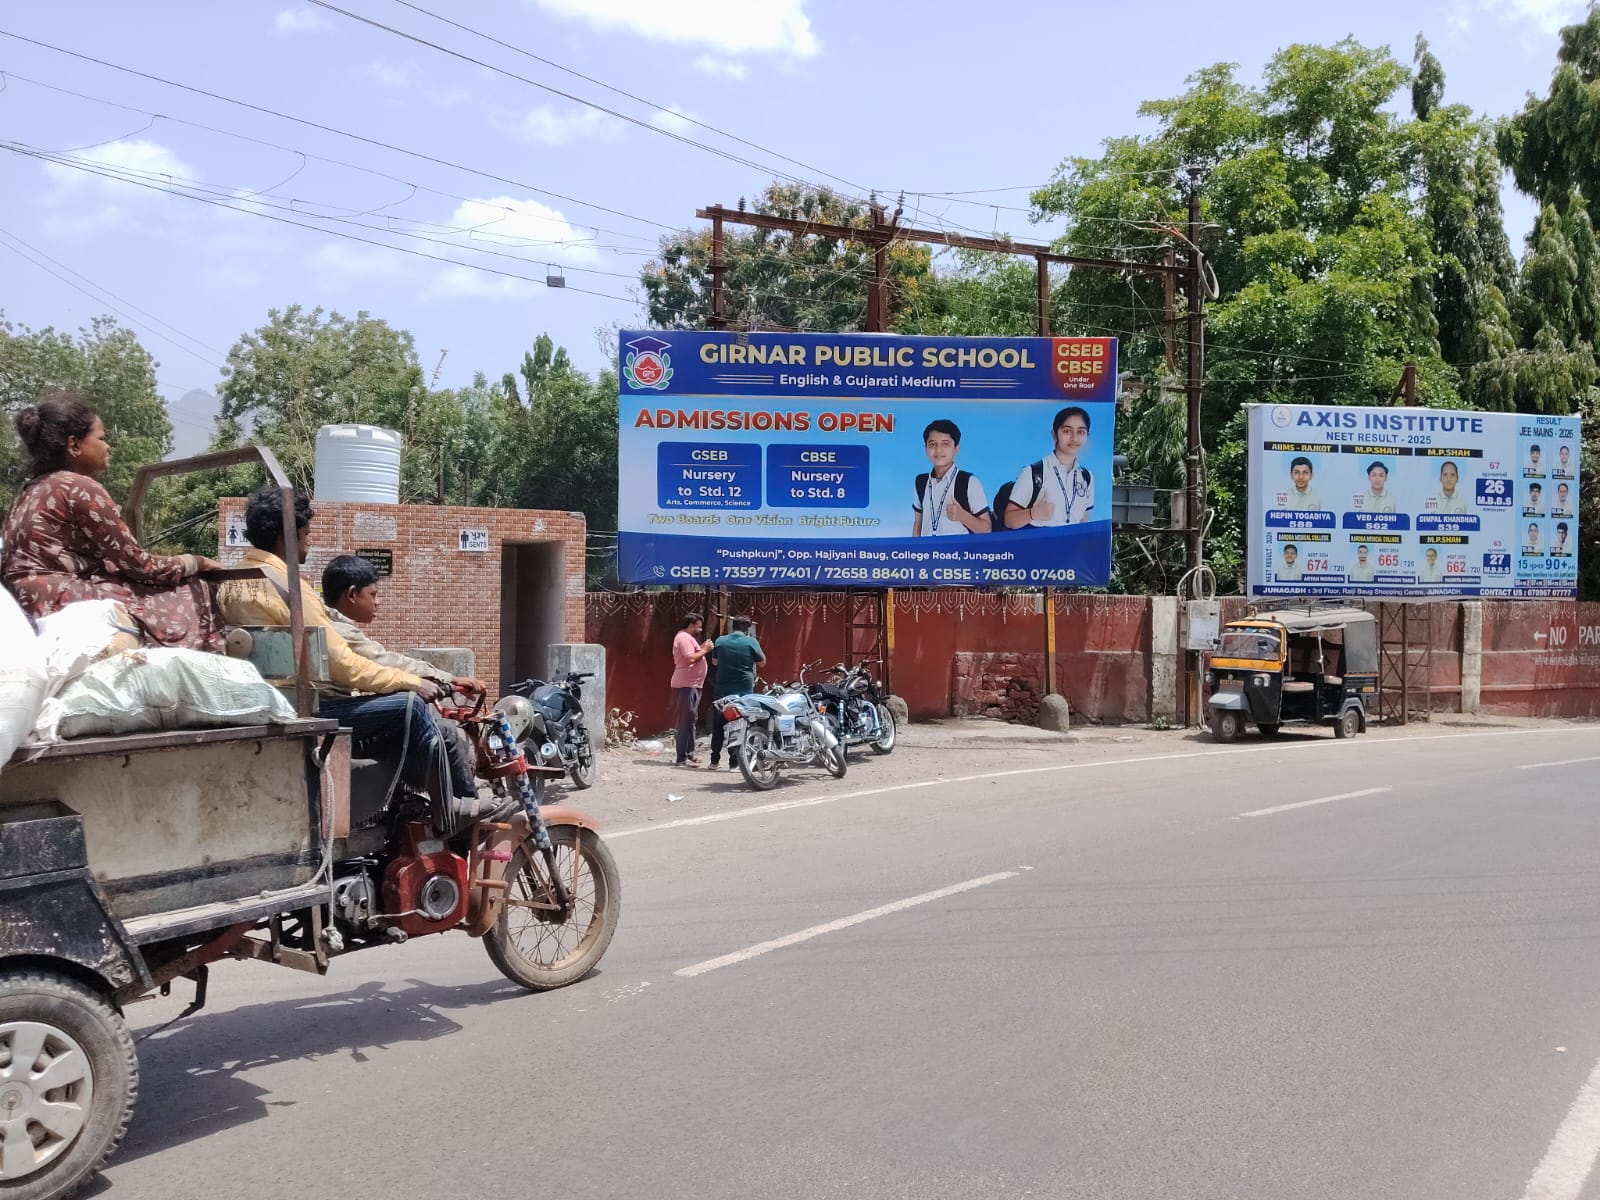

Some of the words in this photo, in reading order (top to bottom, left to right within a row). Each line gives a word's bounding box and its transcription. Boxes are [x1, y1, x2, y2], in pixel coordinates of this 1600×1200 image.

[700, 343, 805, 365] GIRNAR
[815, 345, 914, 367] PUBLIC
[922, 347, 1036, 369] SCHOOL
[1057, 343, 1104, 357] GSEB
[1056, 360, 1103, 374] CBSE
[779, 374, 829, 387] English
[833, 376, 842, 385] &
[845, 375, 898, 388] Gujarati
[901, 376, 956, 388] Medium
[635, 408, 810, 431] ADMISSIONS
[817, 411, 894, 433] OPEN
[1296, 410, 1357, 428] AXIS
[1365, 413, 1483, 433] INSTITUTE
[1536, 416, 1562, 425] RESULT
[1326, 431, 1354, 442] NEET
[1357, 433, 1398, 443] RESULT
[1407, 434, 1432, 445] 2025
[1519, 427, 1531, 436] JEE
[1533, 427, 1553, 437] MAINS
[691, 450, 728, 461] GSEB
[1354, 446, 1400, 454] M.P.SHAH
[1427, 449, 1471, 457] M.P.SHAH
[800, 452, 836, 463] CBSE
[682, 468, 736, 482] Nursery
[791, 470, 844, 484] Nursery
[677, 486, 692, 497] to
[699, 486, 725, 497] Std.
[728, 486, 742, 497] 12
[1484, 479, 1505, 494] 26
[790, 487, 805, 498] to
[807, 487, 833, 499] Std.
[837, 488, 846, 499] 8
[648, 514, 673, 524] Two
[676, 514, 720, 525] Boards
[726, 515, 752, 525] One
[755, 514, 792, 526] Vision
[798, 514, 837, 528] Bright
[839, 516, 880, 527] Future
[1374, 514, 1397, 522] JOSHI
[1366, 522, 1389, 530] 562
[1438, 523, 1460, 531] 539
[788, 550, 813, 560] Opp.
[815, 550, 857, 561] Hajiyani
[859, 551, 888, 561] Baug,
[891, 551, 930, 562] College
[932, 551, 961, 562] Road,
[963, 551, 1015, 562] Junagadh
[1378, 554, 1399, 567] 665
[1489, 554, 1505, 565] 27
[1307, 559, 1328, 571] 674
[1446, 561, 1466, 573] 662
[1518, 559, 1528, 569] 15
[670, 566, 711, 578] GSEB
[722, 566, 766, 578] 73597
[769, 566, 811, 579] 77401
[814, 566, 821, 580] /
[824, 567, 868, 579] 72658
[871, 568, 915, 579] 88401
[919, 568, 929, 580] &
[932, 568, 971, 580] CBSE
[983, 568, 1026, 580] 78630
[1030, 569, 1076, 581] 07408
[1262, 586, 1306, 594] JUNAGADH
[1374, 589, 1403, 597] Shopping
[1480, 588, 1512, 596] CONTACT
[1550, 626, 1567, 645] NO
